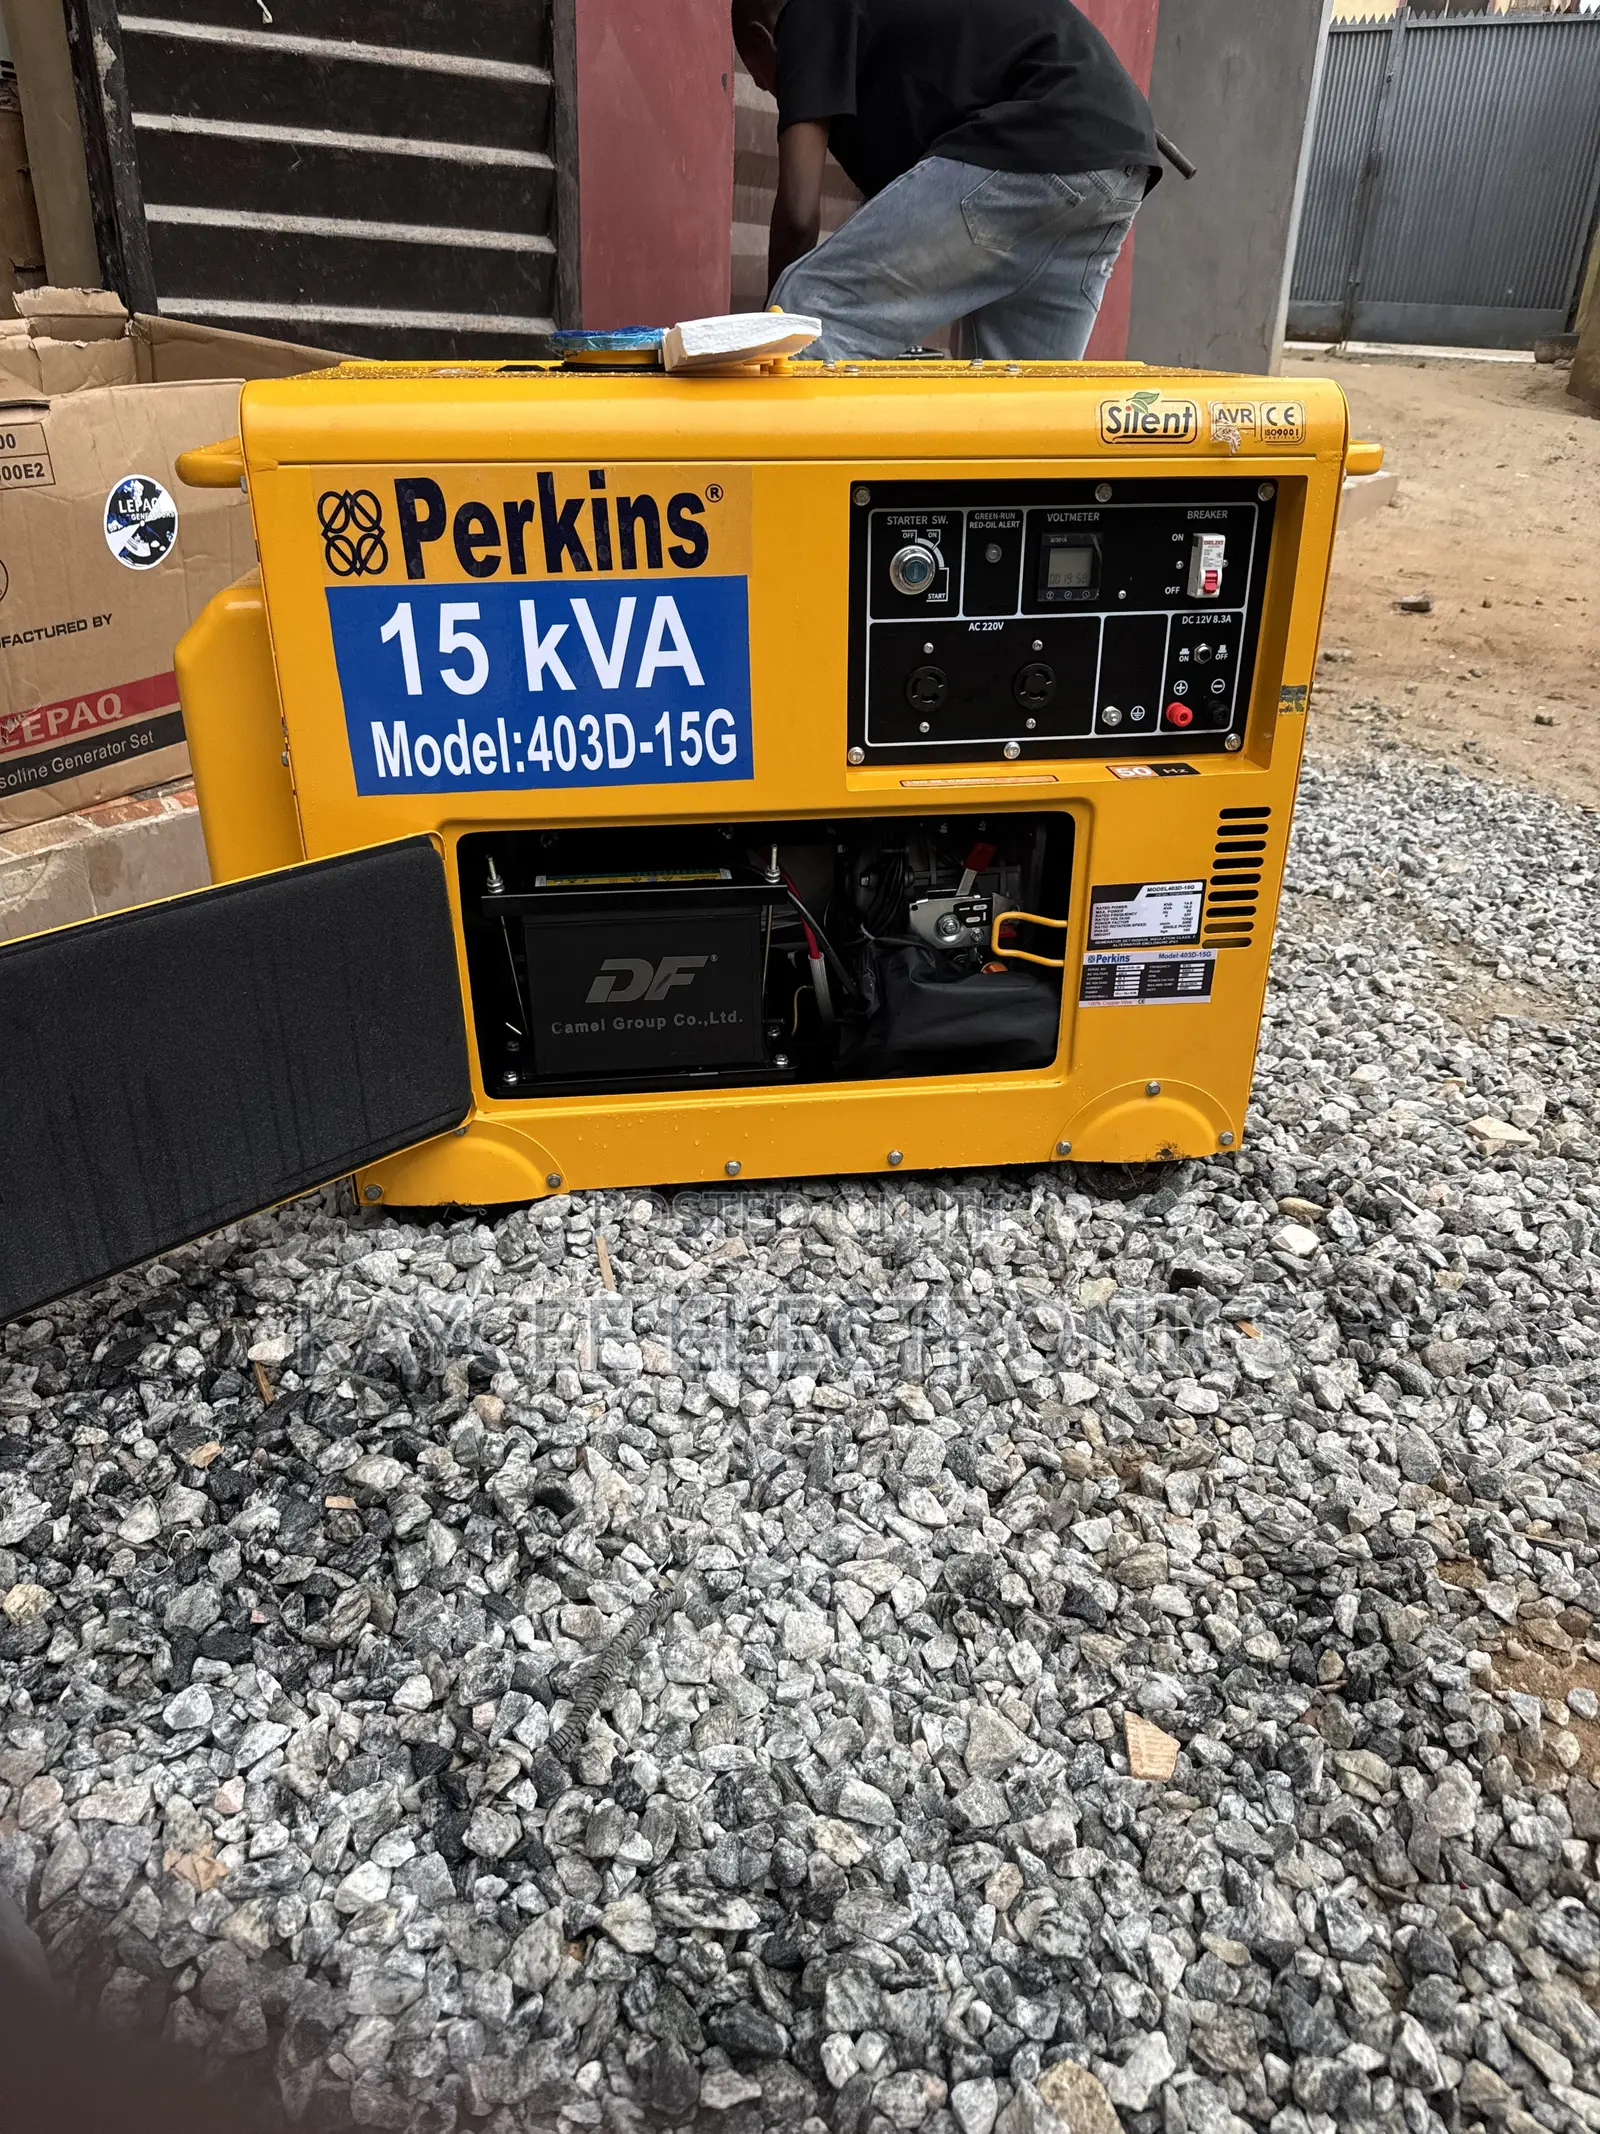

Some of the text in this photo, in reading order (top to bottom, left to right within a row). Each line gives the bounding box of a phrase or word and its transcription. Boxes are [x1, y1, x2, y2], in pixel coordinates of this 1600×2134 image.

[1105, 405, 1193, 434] Silent
[1217, 408, 1254, 424] AVR
[1264, 428, 1299, 437] ISO9001
[0, 462, 45, 481] 00E2
[886, 515, 949, 525] STARTER SW.
[974, 512, 1016, 520] GREEN-RUN
[1046, 512, 1100, 522] VOLTMETER
[1187, 510, 1228, 520] BREAKER
[969, 520, 1020, 529] RED-OIL ALERT
[1171, 533, 1184, 542] ON
[927, 592, 946, 600] START
[1164, 586, 1181, 595] OFF
[1182, 614, 1232, 625] DC 12V 8.3A
[0, 613, 113, 650] FACTURED BY
[968, 621, 1004, 632] AC 220V
[379, 595, 706, 696] 15 kVA
[370, 707, 738, 778] Model:403D-15G
[51, 741, 127, 774] Generator
[129, 730, 154, 749] Set
[1115, 766, 1189, 777] 50 Hz
[1096, 953, 1131, 964] Perkins
[551, 1010, 744, 1035] Camel Group Co.,Ltd.
